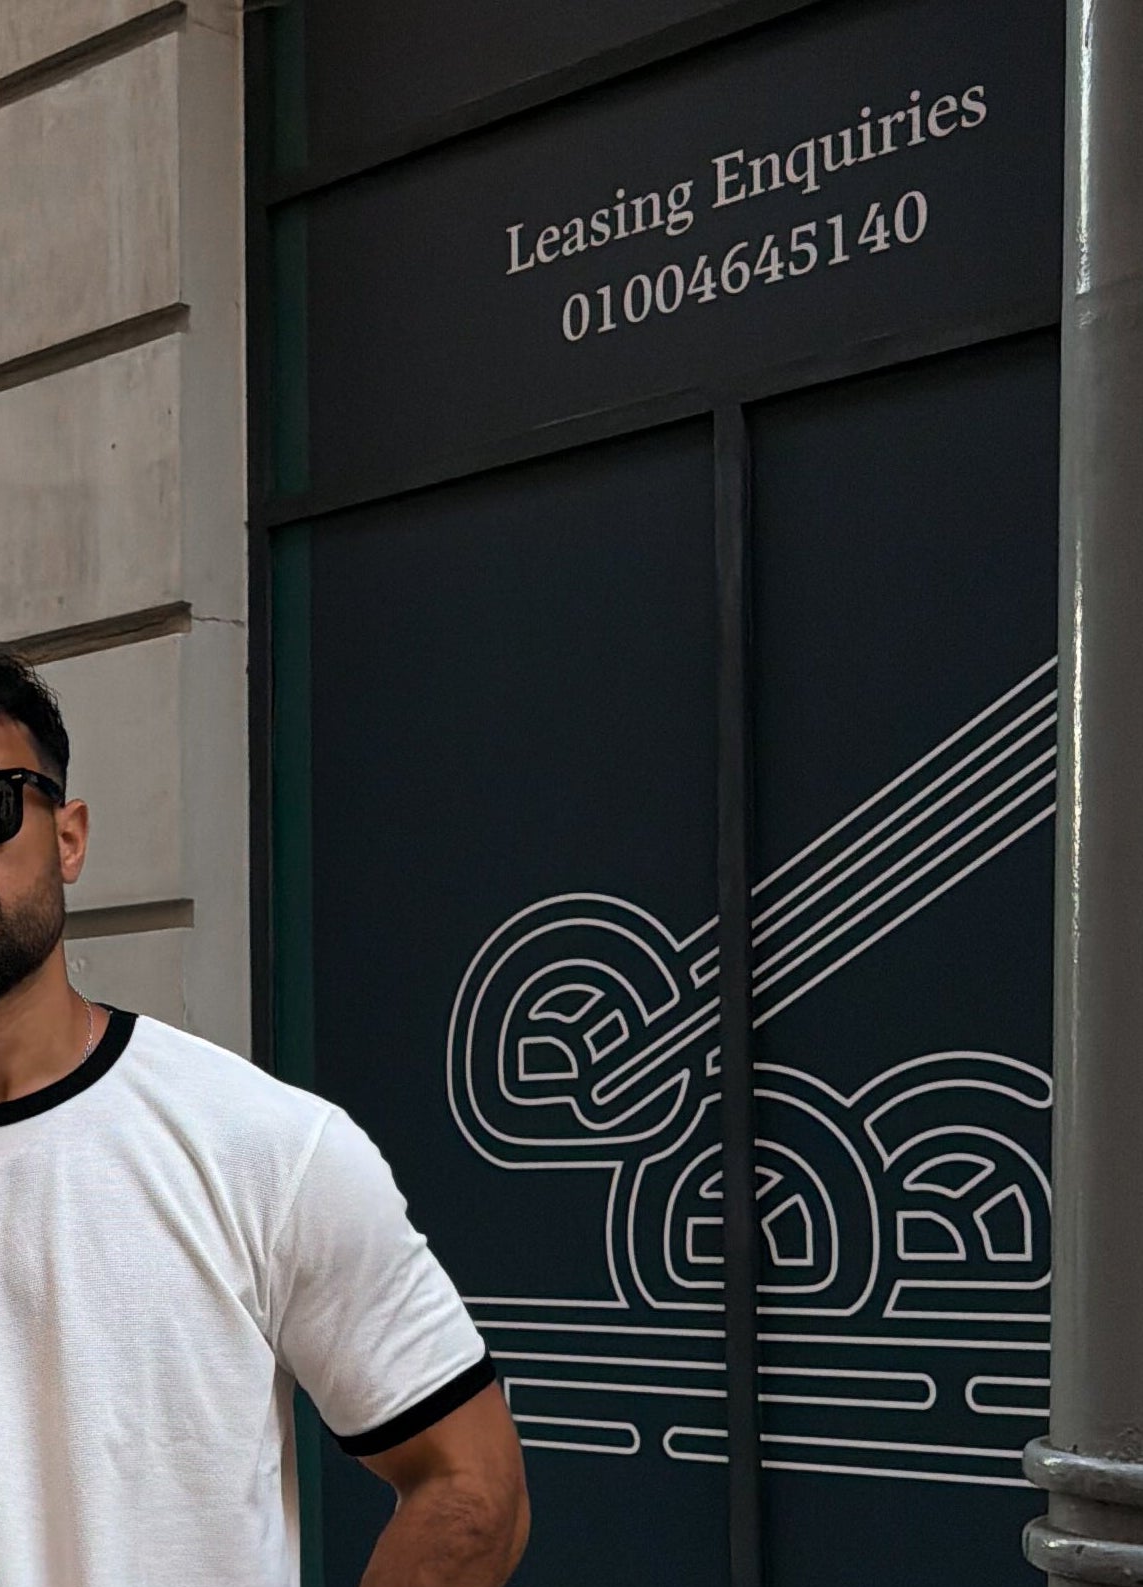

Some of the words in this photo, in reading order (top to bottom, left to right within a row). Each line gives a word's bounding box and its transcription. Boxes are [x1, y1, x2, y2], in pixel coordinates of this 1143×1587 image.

[505, 180, 694, 276] Leasing
[710, 84, 989, 209] Enquiries
[561, 190, 929, 343] 01004645140
